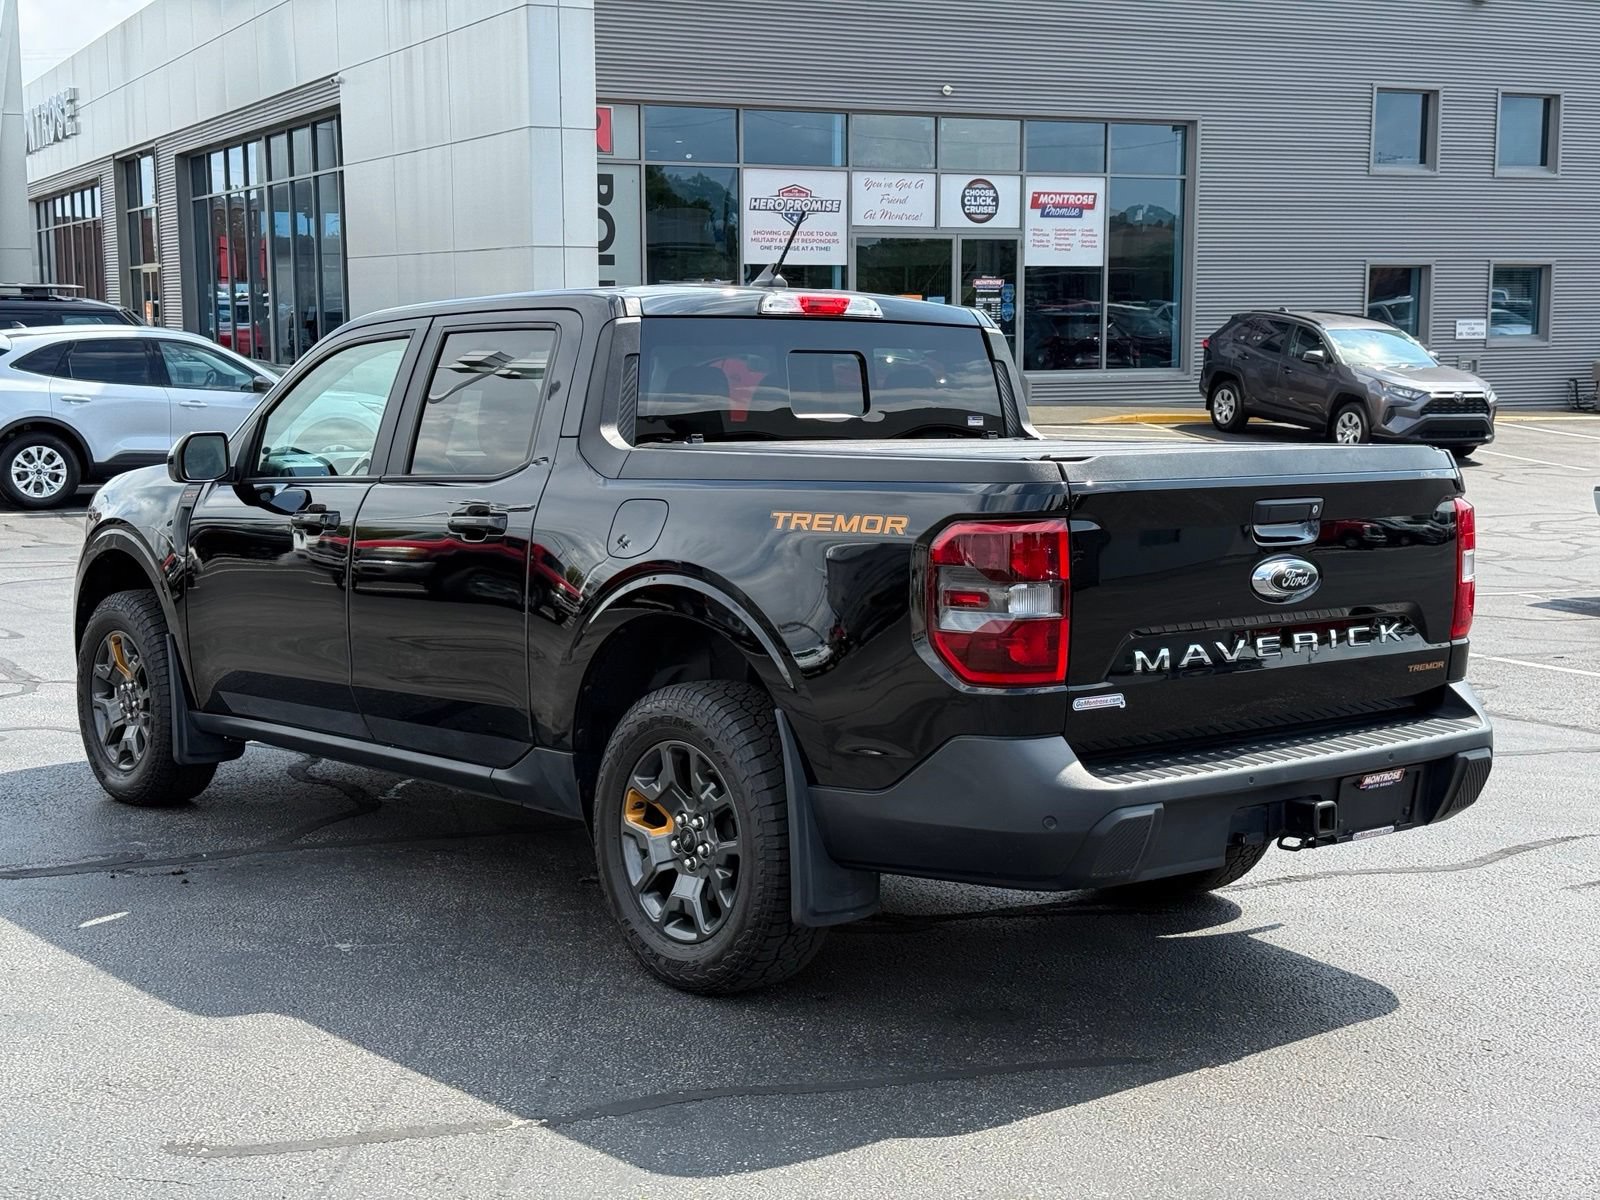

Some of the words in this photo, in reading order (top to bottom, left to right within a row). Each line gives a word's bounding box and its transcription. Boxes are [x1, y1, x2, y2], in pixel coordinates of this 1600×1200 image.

[25, 88, 80, 153] NTROSE
[864, 177, 893, 191] You've
[895, 178, 913, 192] Got
[914, 179, 925, 189] A
[879, 193, 909, 205] Friend
[964, 188, 996, 197] CHOOSE.
[1038, 193, 1095, 205] MONTROSE
[749, 198, 785, 212] HERO
[785, 199, 841, 213] PROMISE
[964, 196, 996, 206] CLICK.
[863, 209, 877, 220] At
[879, 208, 923, 221] Montrose!
[964, 205, 996, 214] CRUISE!
[1044, 204, 1080, 216] Promise
[752, 229, 782, 237] SHOWING
[770, 510, 910, 535] TREMOR
[1281, 568, 1310, 588] Ford
[1133, 622, 1402, 673] MAVERICK
[1407, 660, 1445, 673] TREMOR
[1363, 769, 1402, 785] MONTROSE
